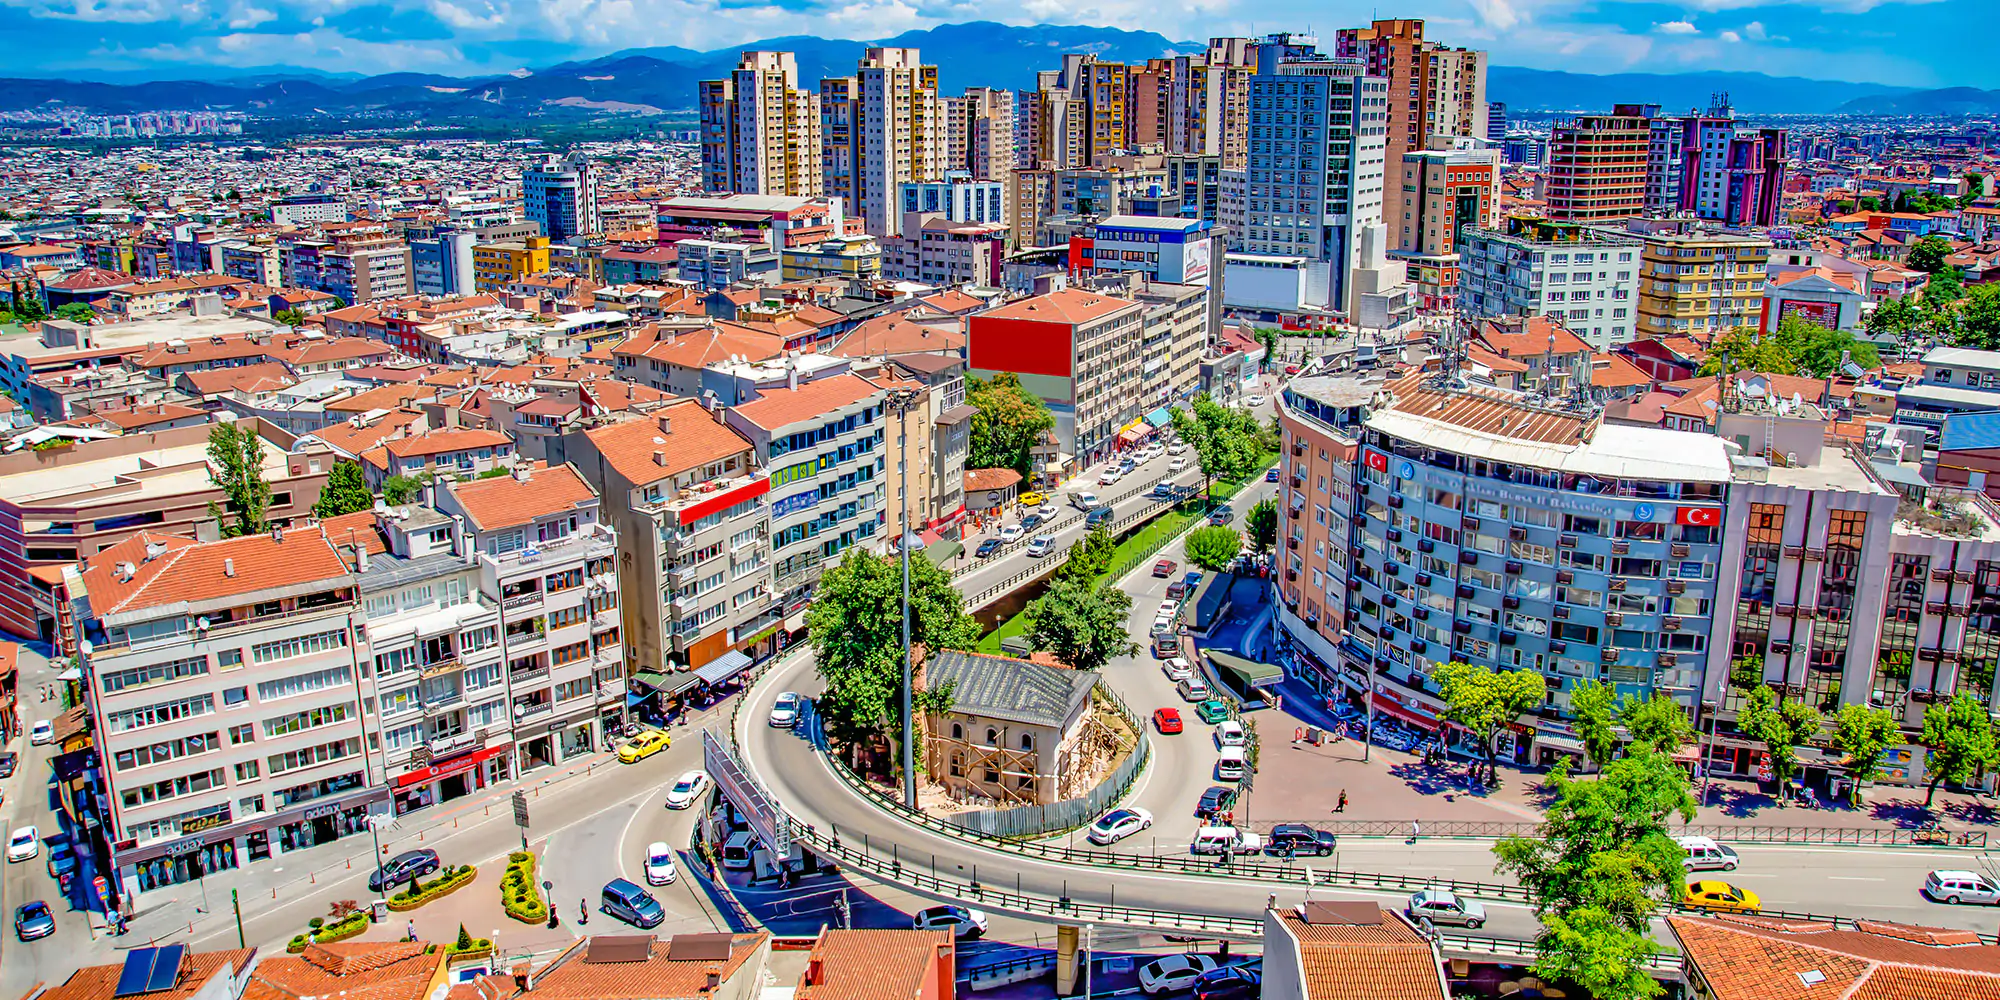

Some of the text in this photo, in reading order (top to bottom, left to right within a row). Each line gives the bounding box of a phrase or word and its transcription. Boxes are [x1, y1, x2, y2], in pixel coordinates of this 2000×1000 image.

[441, 757, 473, 771] vodafone
[306, 803, 341, 820] addax
[165, 837, 205, 855] addax
